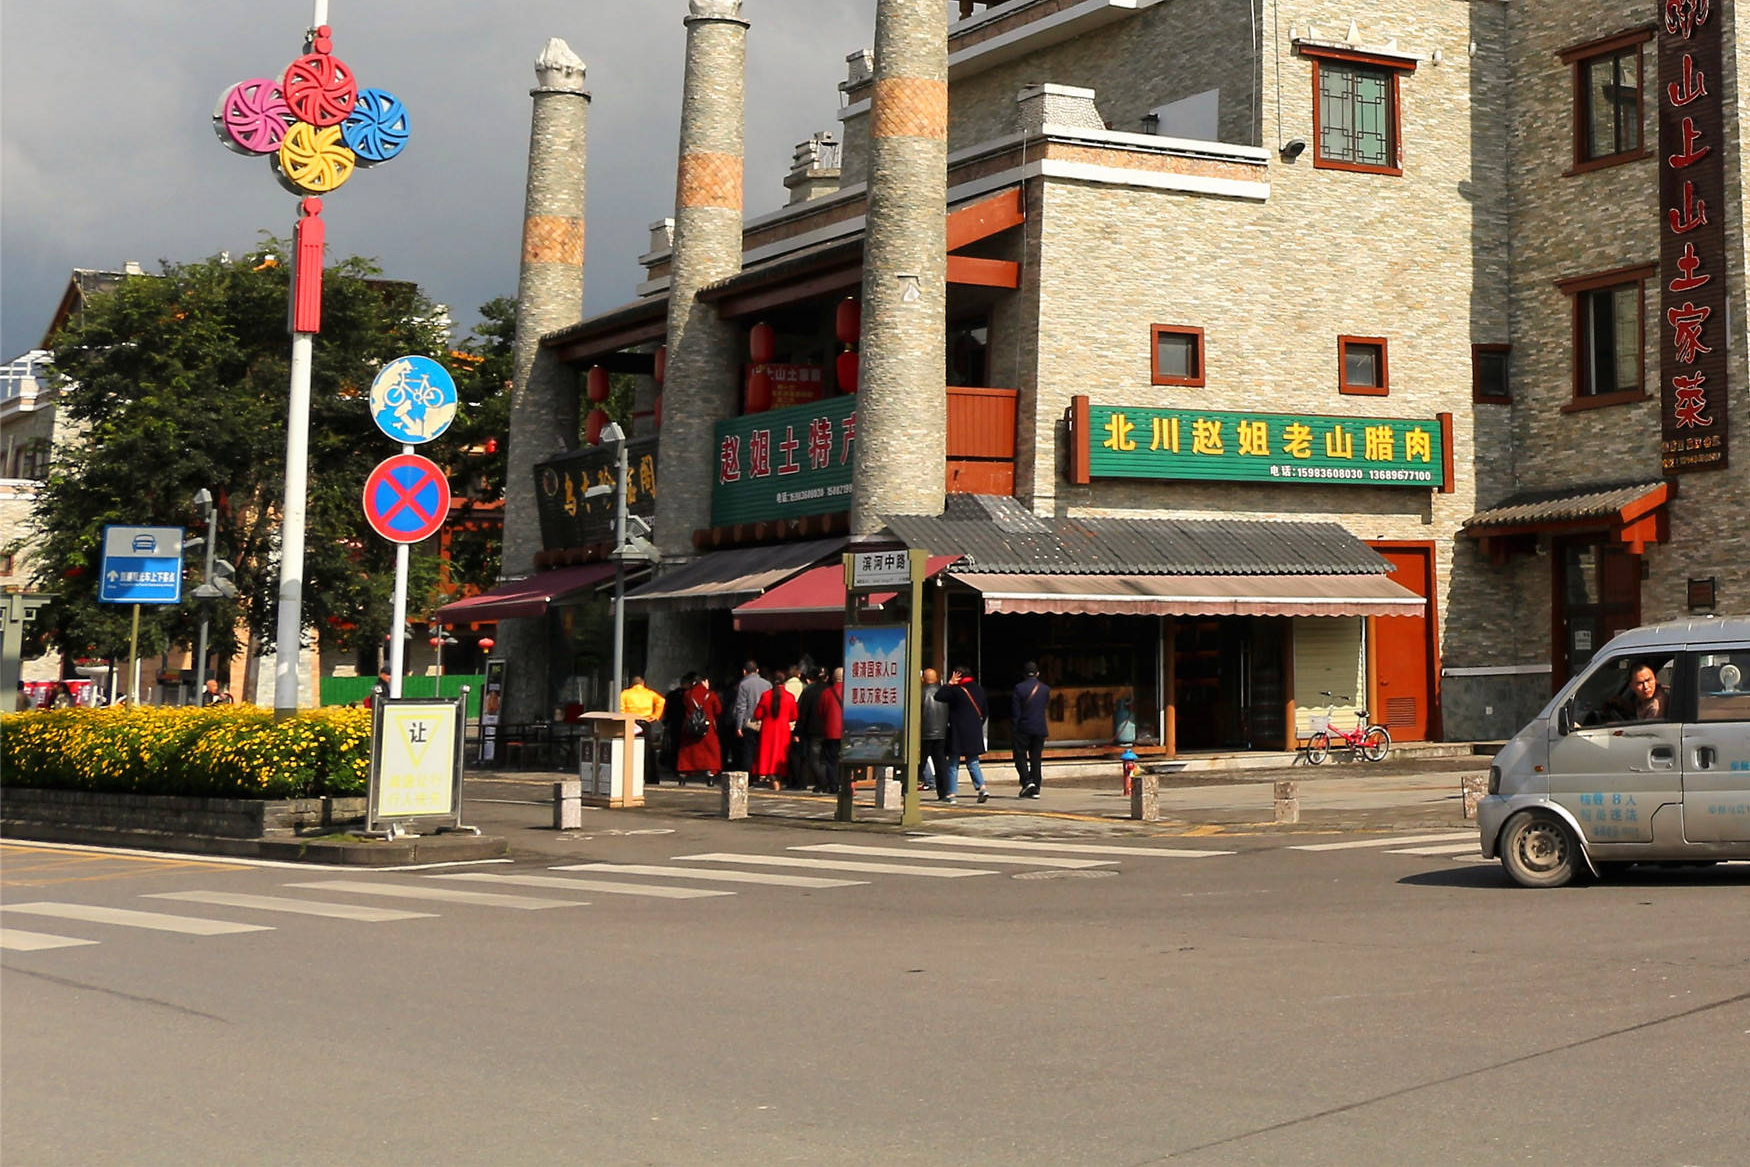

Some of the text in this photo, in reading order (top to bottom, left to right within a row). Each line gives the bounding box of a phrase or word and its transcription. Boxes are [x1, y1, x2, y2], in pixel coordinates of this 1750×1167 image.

[1103, 413, 1432, 463] 北川赵姐老山腊肉
[1369, 469, 1432, 481] 13689677100
[862, 553, 906, 571] 滨河中路
[409, 722, 427, 743] 让
